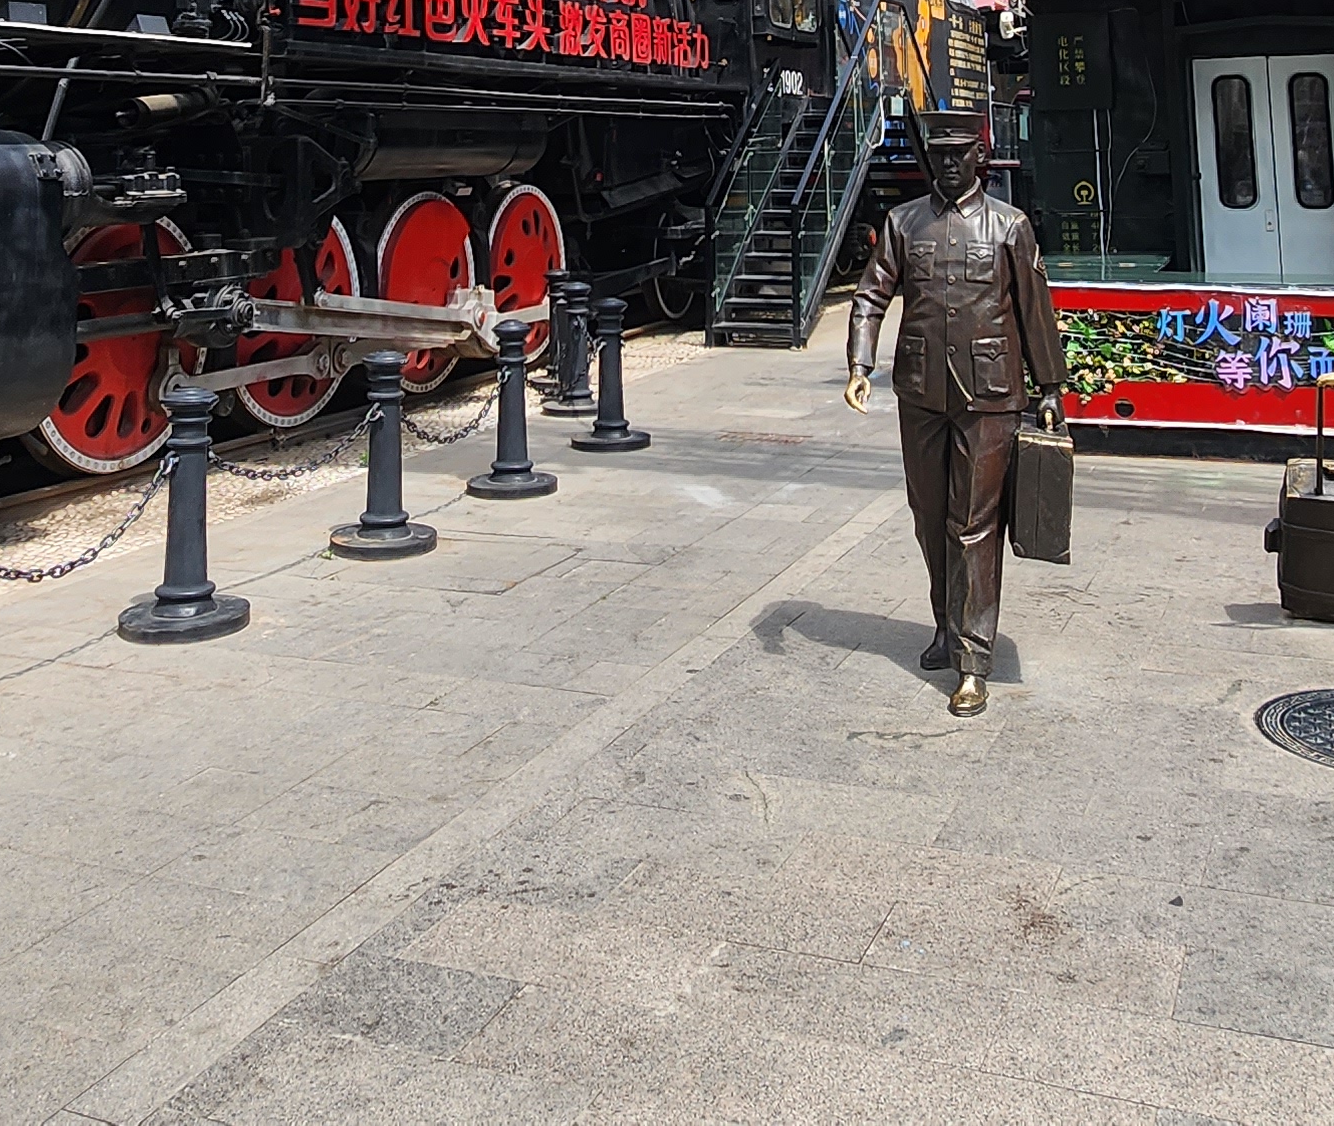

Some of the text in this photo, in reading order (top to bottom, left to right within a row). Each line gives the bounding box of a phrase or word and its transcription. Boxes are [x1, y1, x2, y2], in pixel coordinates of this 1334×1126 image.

[558, 0, 710, 70] 激发商圈新活力
[779, 69, 804, 95] 1902
[1156, 297, 1313, 347] 灯火阑珊
